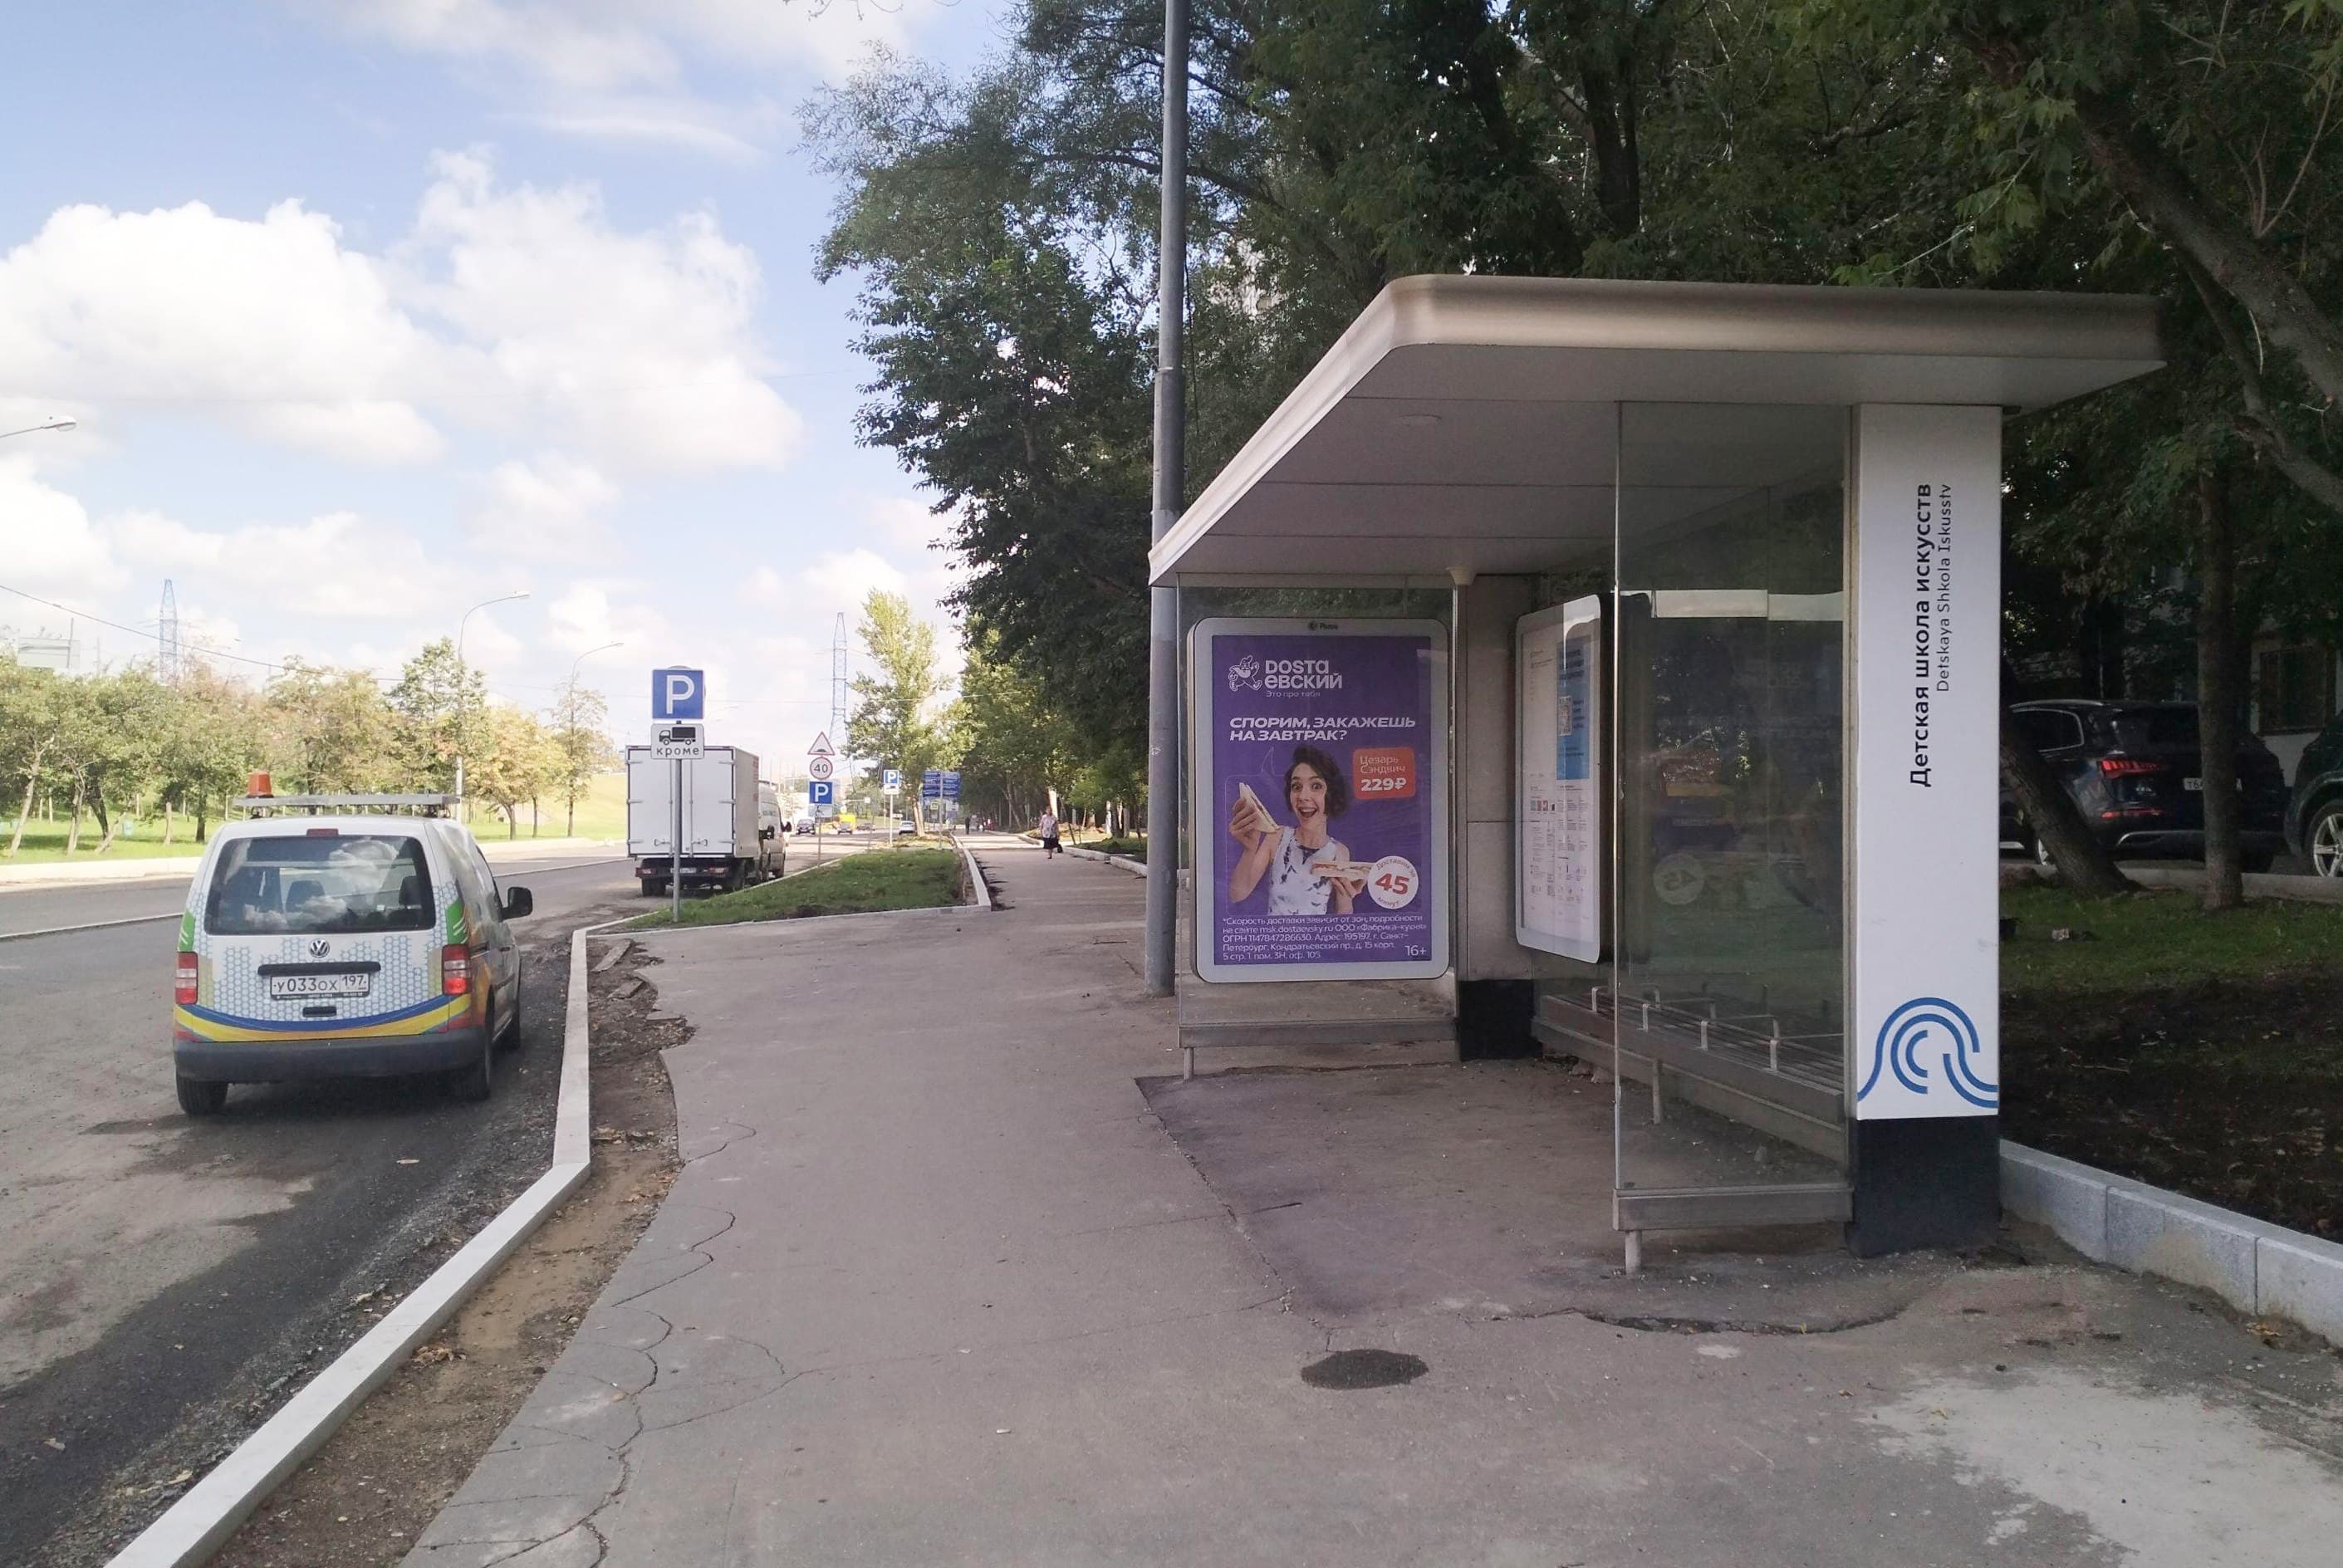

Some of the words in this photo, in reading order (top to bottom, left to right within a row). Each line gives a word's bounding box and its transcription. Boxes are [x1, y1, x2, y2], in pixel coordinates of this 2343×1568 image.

[1938, 484, 1952, 552] Iskusstv
[1917, 483, 1935, 592] искусств
[1938, 557, 1951, 613] Shkola
[1915, 599, 1930, 679] школа
[1937, 617, 1952, 692] Detskaya
[666, 674, 695, 715] P
[1229, 717, 1311, 729] СПОРИМ,
[1314, 718, 1416, 728] ЗАКАЖЕШЬ
[1229, 730, 1255, 742] НА
[1258, 730, 1348, 742] ЗАВТРАК?
[1910, 685, 1931, 787] Детская
[656, 747, 700, 758] кроме
[814, 763, 828, 773] 40
[814, 783, 829, 802] P
[1375, 873, 1409, 894] 45
[1369, 914, 1423, 924] подробности
[1335, 924, 1355, 932] ООО
[1223, 933, 1247, 943] ОГРН
[1404, 944, 1427, 956] 16+
[341, 975, 365, 987] 197
